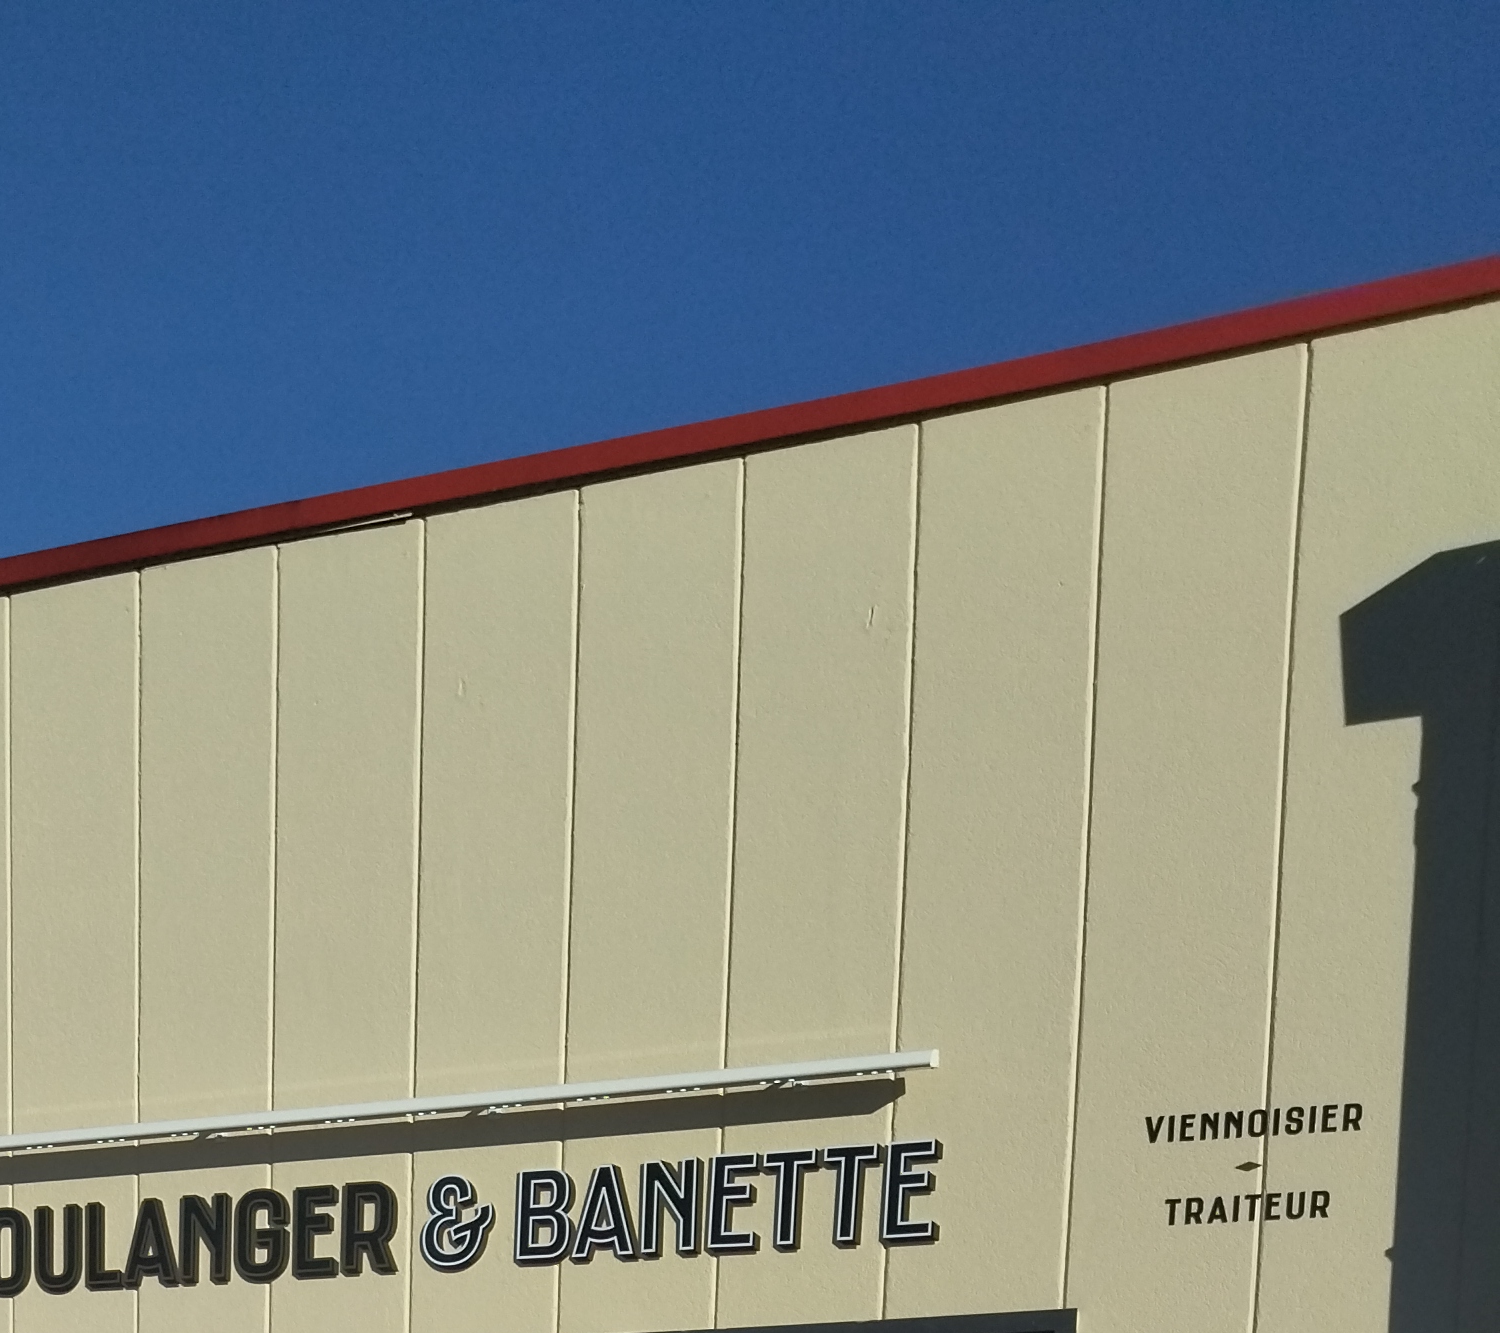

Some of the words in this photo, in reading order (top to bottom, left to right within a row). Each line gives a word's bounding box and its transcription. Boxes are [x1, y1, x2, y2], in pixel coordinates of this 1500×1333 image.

[1145, 1103, 1363, 1144] VIENNOISIER
[421, 1175, 495, 1271] &
[513, 1138, 943, 1266] BANETTE
[1164, 1190, 1331, 1226] TRAITEUR
